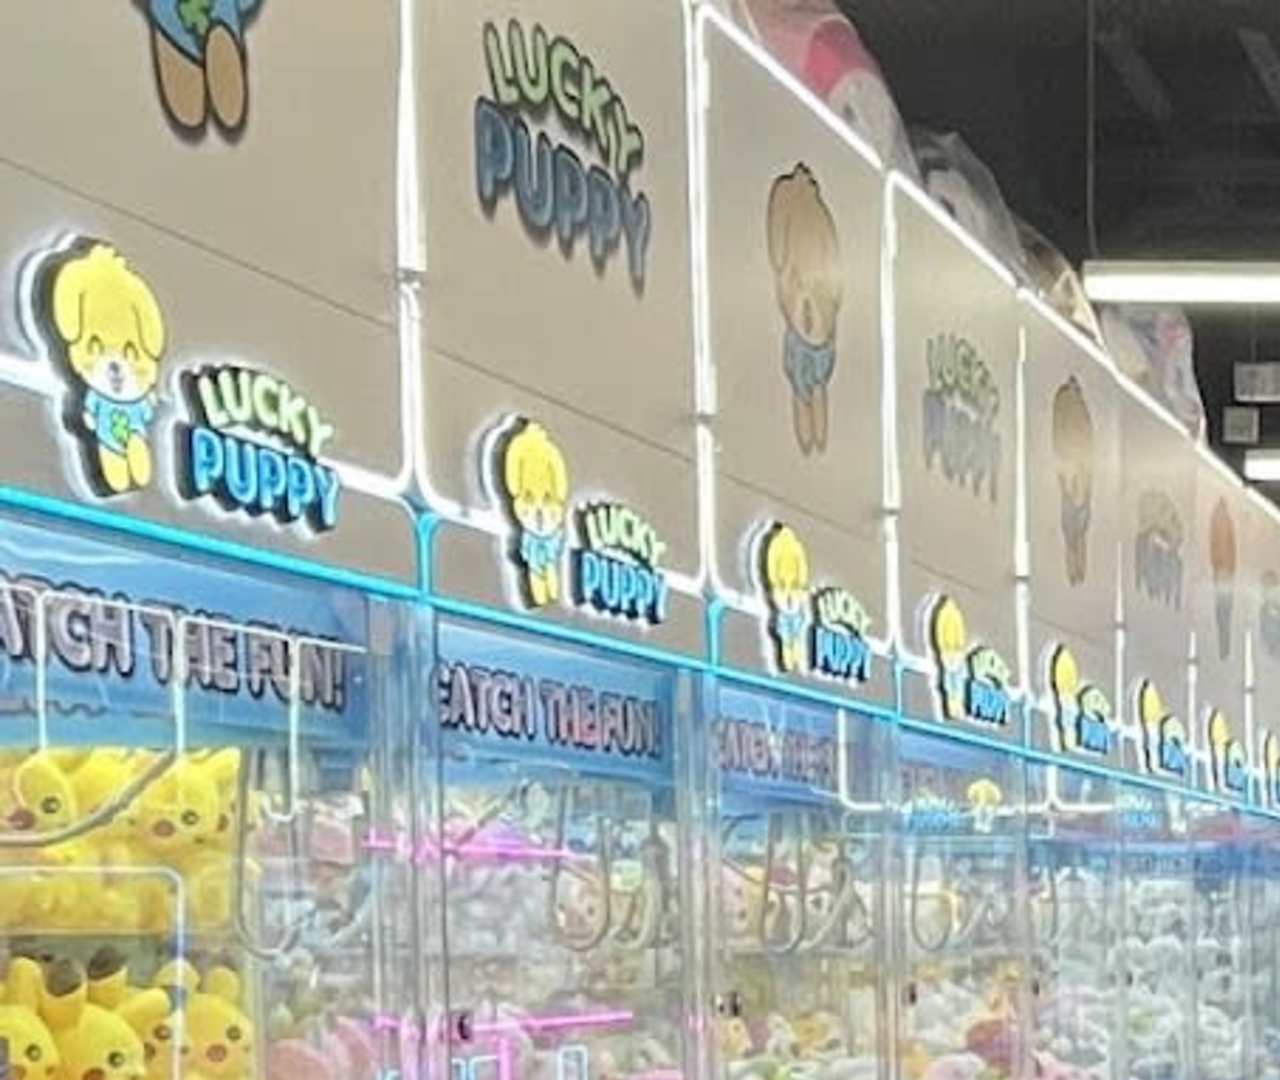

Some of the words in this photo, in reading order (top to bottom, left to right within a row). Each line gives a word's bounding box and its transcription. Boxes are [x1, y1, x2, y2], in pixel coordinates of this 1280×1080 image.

[484, 18, 645, 177] LUCKY
[474, 95, 651, 300] PUPPY
[192, 365, 335, 458] LUCKY
[186, 425, 340, 530] PUPPY
[578, 548, 670, 623] PUPPY
[581, 501, 668, 566] LUCKY
[0, 570, 134, 678] ATCH
